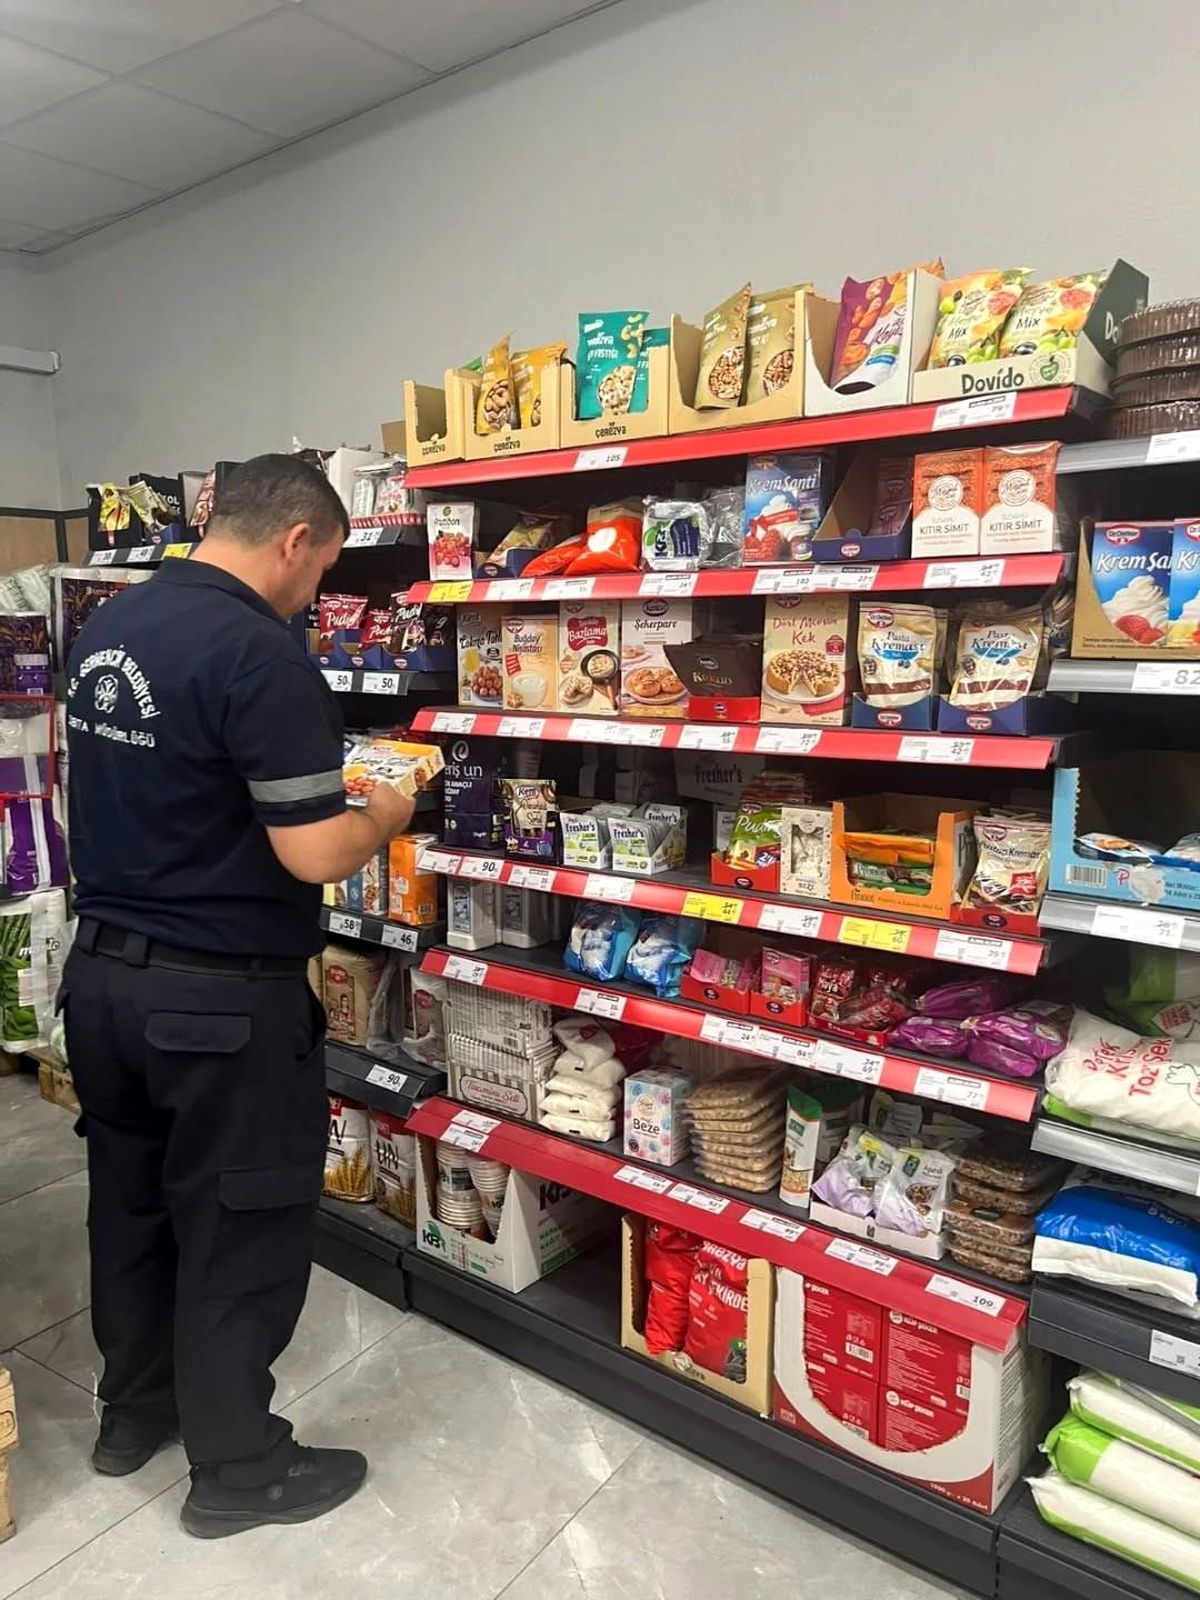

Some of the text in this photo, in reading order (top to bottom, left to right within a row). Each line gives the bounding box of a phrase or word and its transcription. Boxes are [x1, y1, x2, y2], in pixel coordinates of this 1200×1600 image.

[1015, 315, 1041, 330] Mix
[919, 522, 970, 535] KITIR SİMİT
[989, 519, 1043, 532] KITIR SİMİT
[1096, 552, 1147, 573] Krem
[634, 618, 678, 630] Şekerpare
[568, 626, 607, 643] Bazlama
[791, 632, 816, 646] Kek
[337, 674, 348, 686] 50
[381, 677, 393, 689] 50
[463, 765, 483, 778] un
[565, 822, 596, 833] Fresher's
[613, 828, 645, 840] Fresher's
[481, 861, 496, 872] 90
[344, 918, 355, 930] 58
[400, 933, 412, 945] 46
[386, 1073, 401, 1085] 90
[633, 1118, 660, 1136] Beze
[972, 1295, 994, 1309] 109
